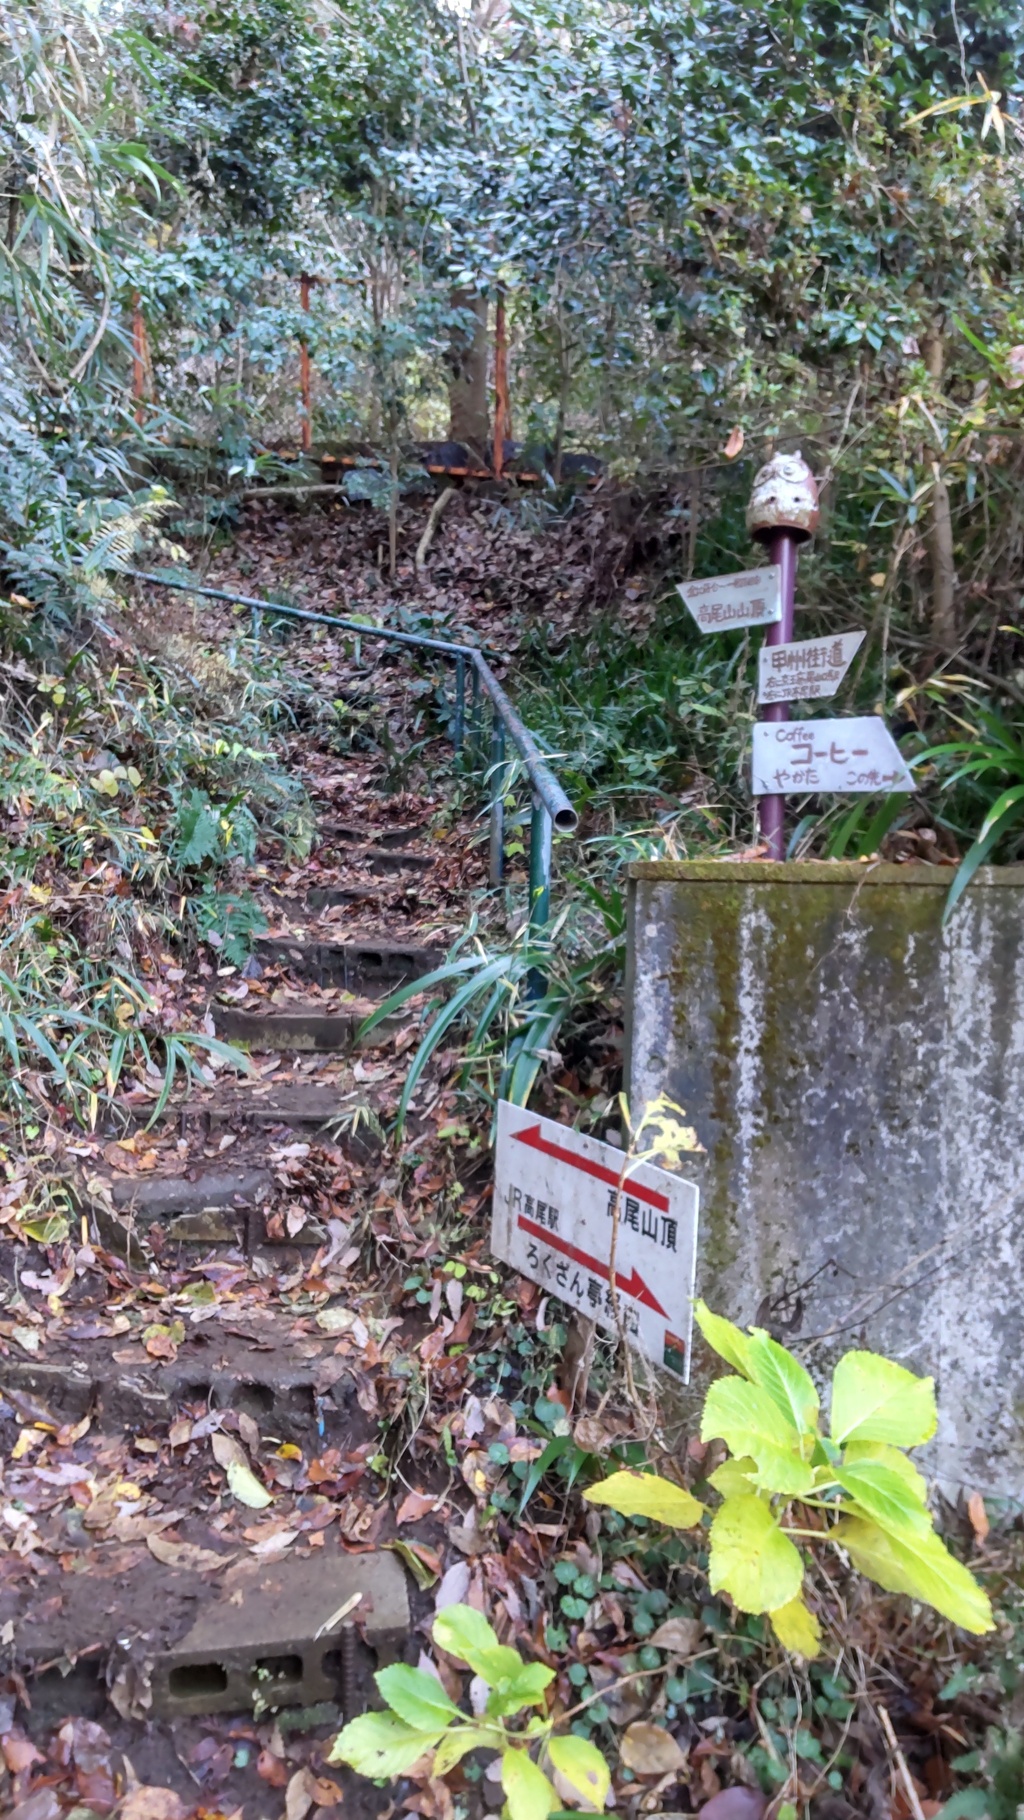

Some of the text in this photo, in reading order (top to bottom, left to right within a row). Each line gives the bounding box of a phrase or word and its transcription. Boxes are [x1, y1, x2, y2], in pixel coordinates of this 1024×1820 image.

[697, 598, 766, 624] 高尾山山頂
[771, 638, 847, 672] 甲州街道
[775, 727, 815, 742] Coffee
[790, 742, 869, 765] コーヒー
[846, 769, 881, 785] この先
[504, 1183, 559, 1232] JR高尾駅
[607, 1188, 678, 1253] 高尾山頂
